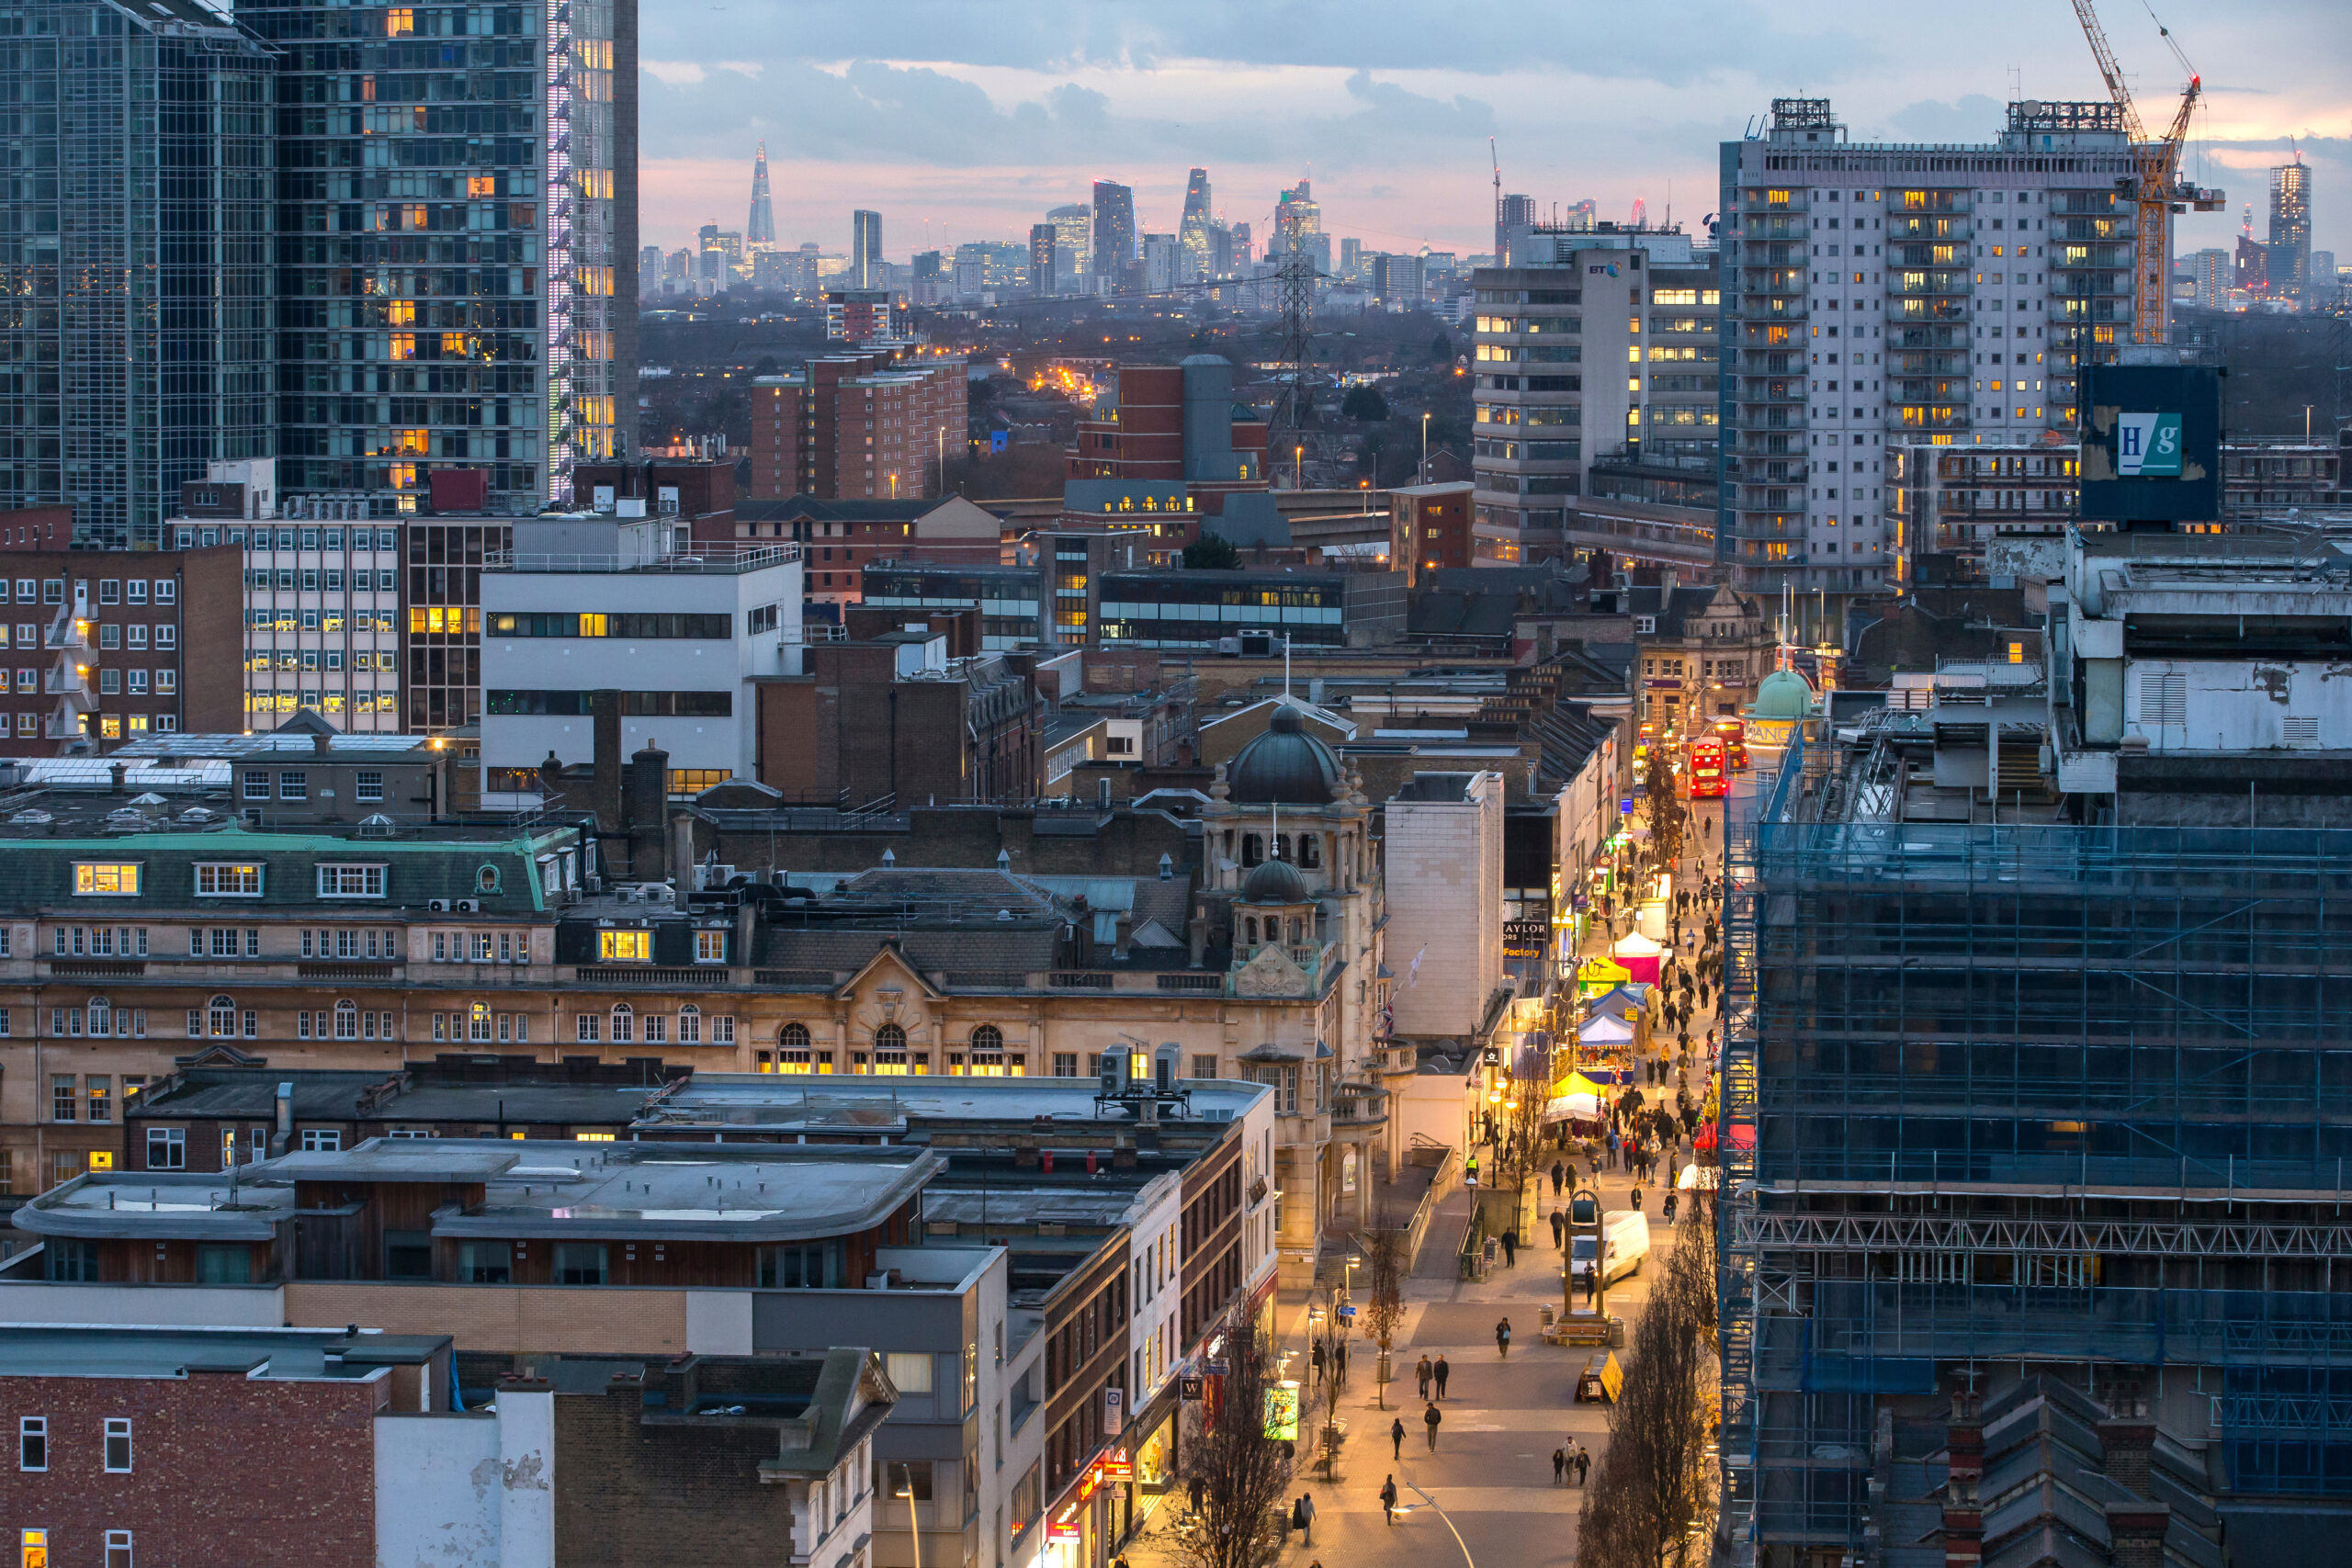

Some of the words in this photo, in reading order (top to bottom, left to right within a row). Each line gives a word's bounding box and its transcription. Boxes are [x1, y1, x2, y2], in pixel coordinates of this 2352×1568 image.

[1589, 265, 1606, 274] BT
[1503, 924, 1546, 933] AYLOR
[1503, 948, 1540, 958] Factory
[1185, 1382, 1198, 1393] W
